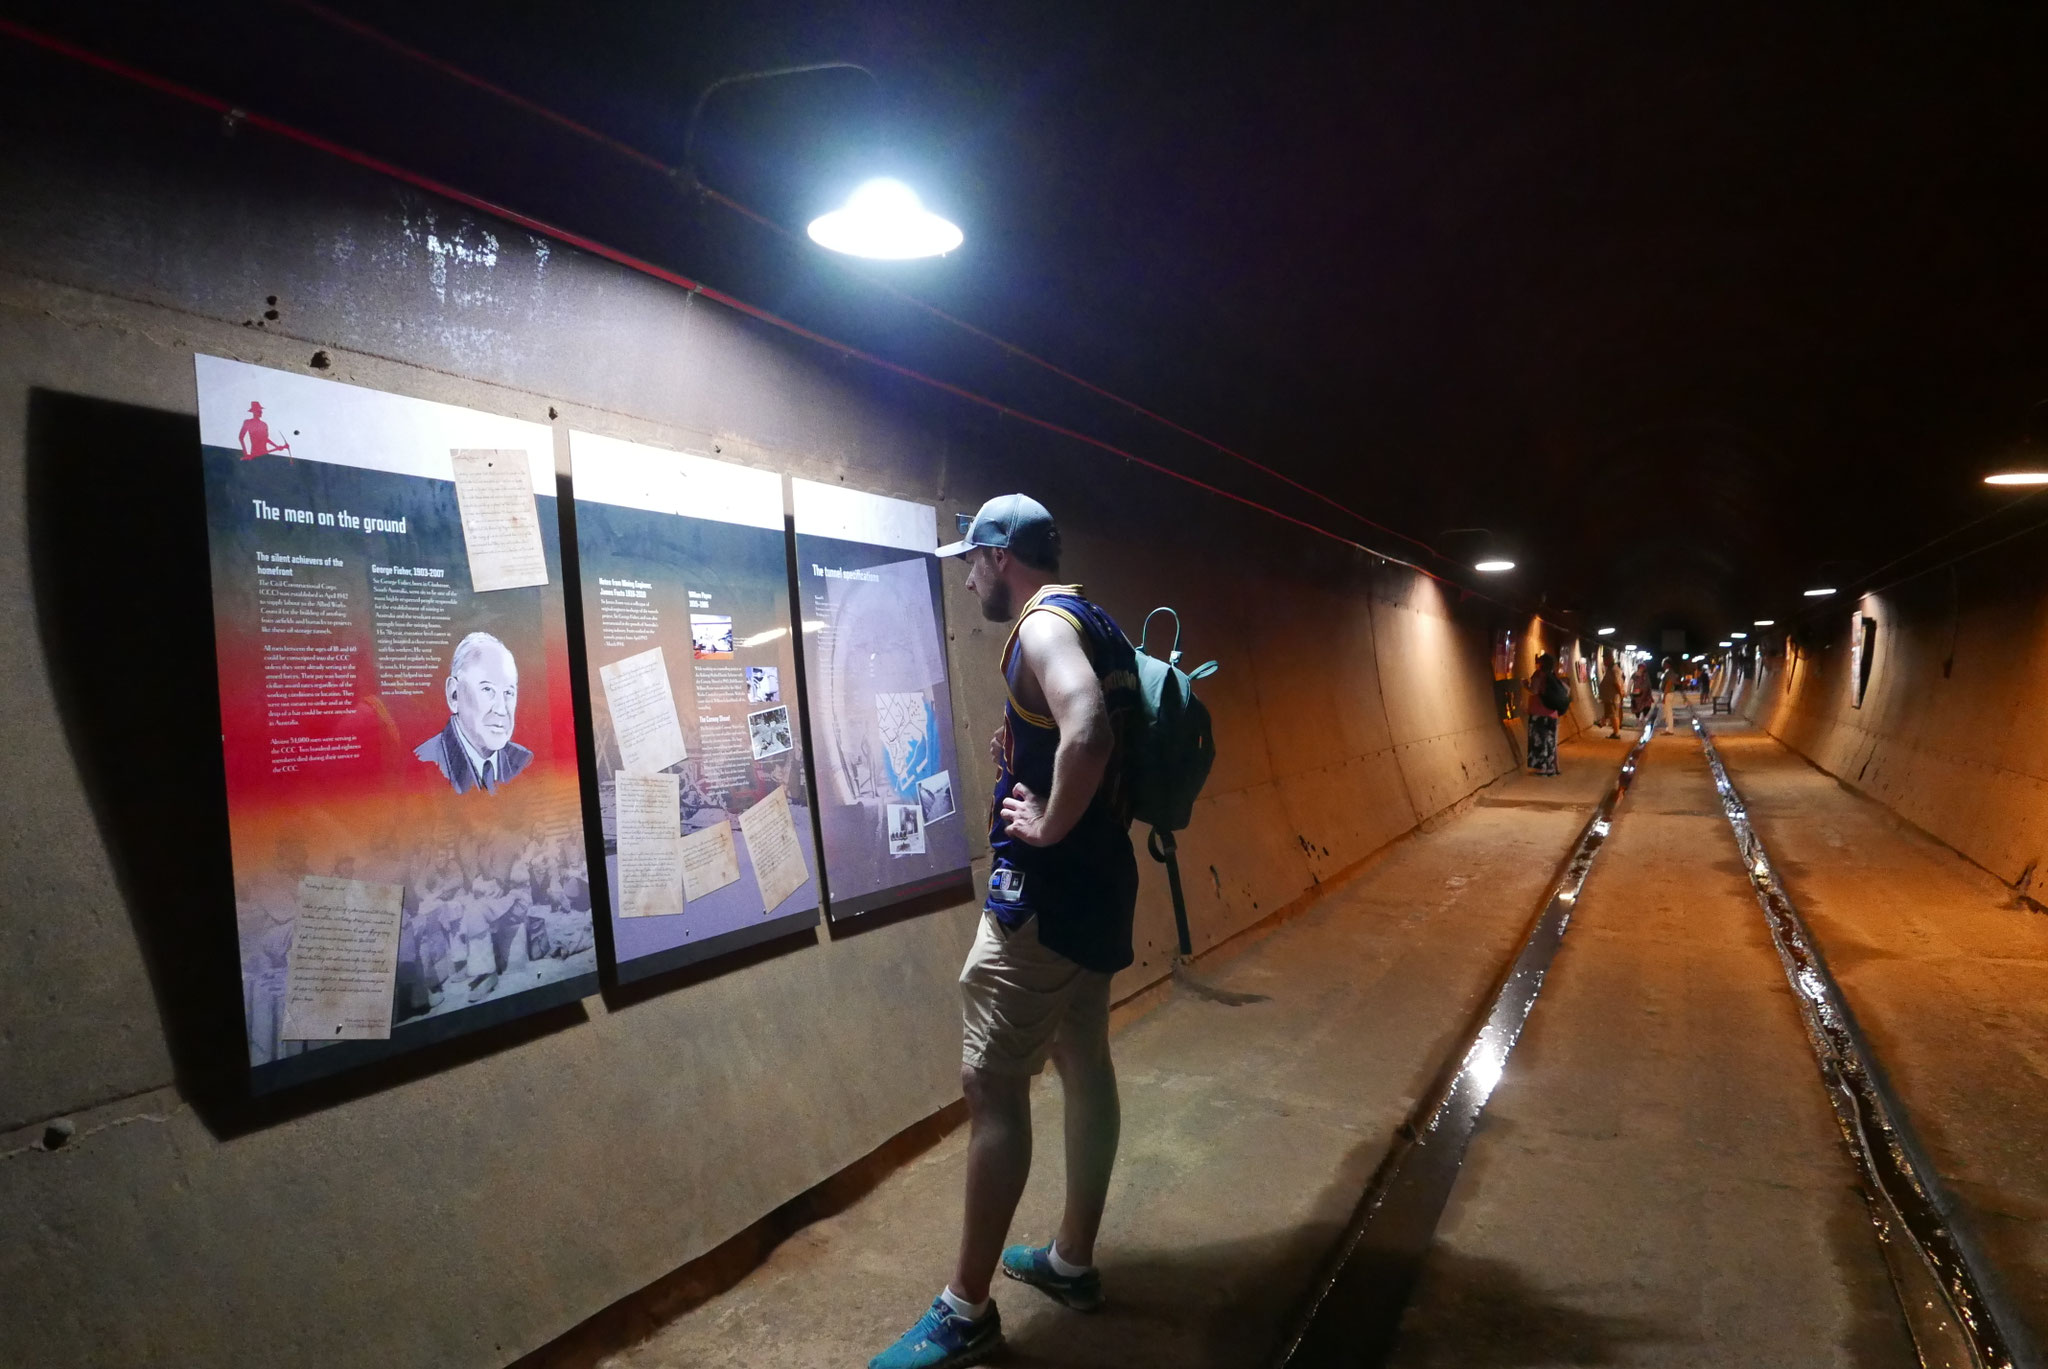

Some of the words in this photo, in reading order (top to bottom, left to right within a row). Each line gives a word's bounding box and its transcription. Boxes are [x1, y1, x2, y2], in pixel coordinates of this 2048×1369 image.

[253, 500, 280, 520] The
[284, 509, 314, 524] men
[318, 513, 334, 526] on
[338, 510, 360, 528] the
[364, 517, 406, 533] ground
[256, 551, 269, 562] The
[271, 552, 290, 563] silent
[292, 554, 323, 566] achievers
[324, 556, 331, 566] of
[332, 557, 344, 567] the
[257, 565, 293, 576] homefront
[372, 564, 393, 576] George
[393, 565, 412, 577] Fisher,
[413, 566, 444, 578] 1903-2007
[812, 563, 823, 577] The
[824, 565, 842, 579] tunnel
[843, 567, 879, 585] specifications
